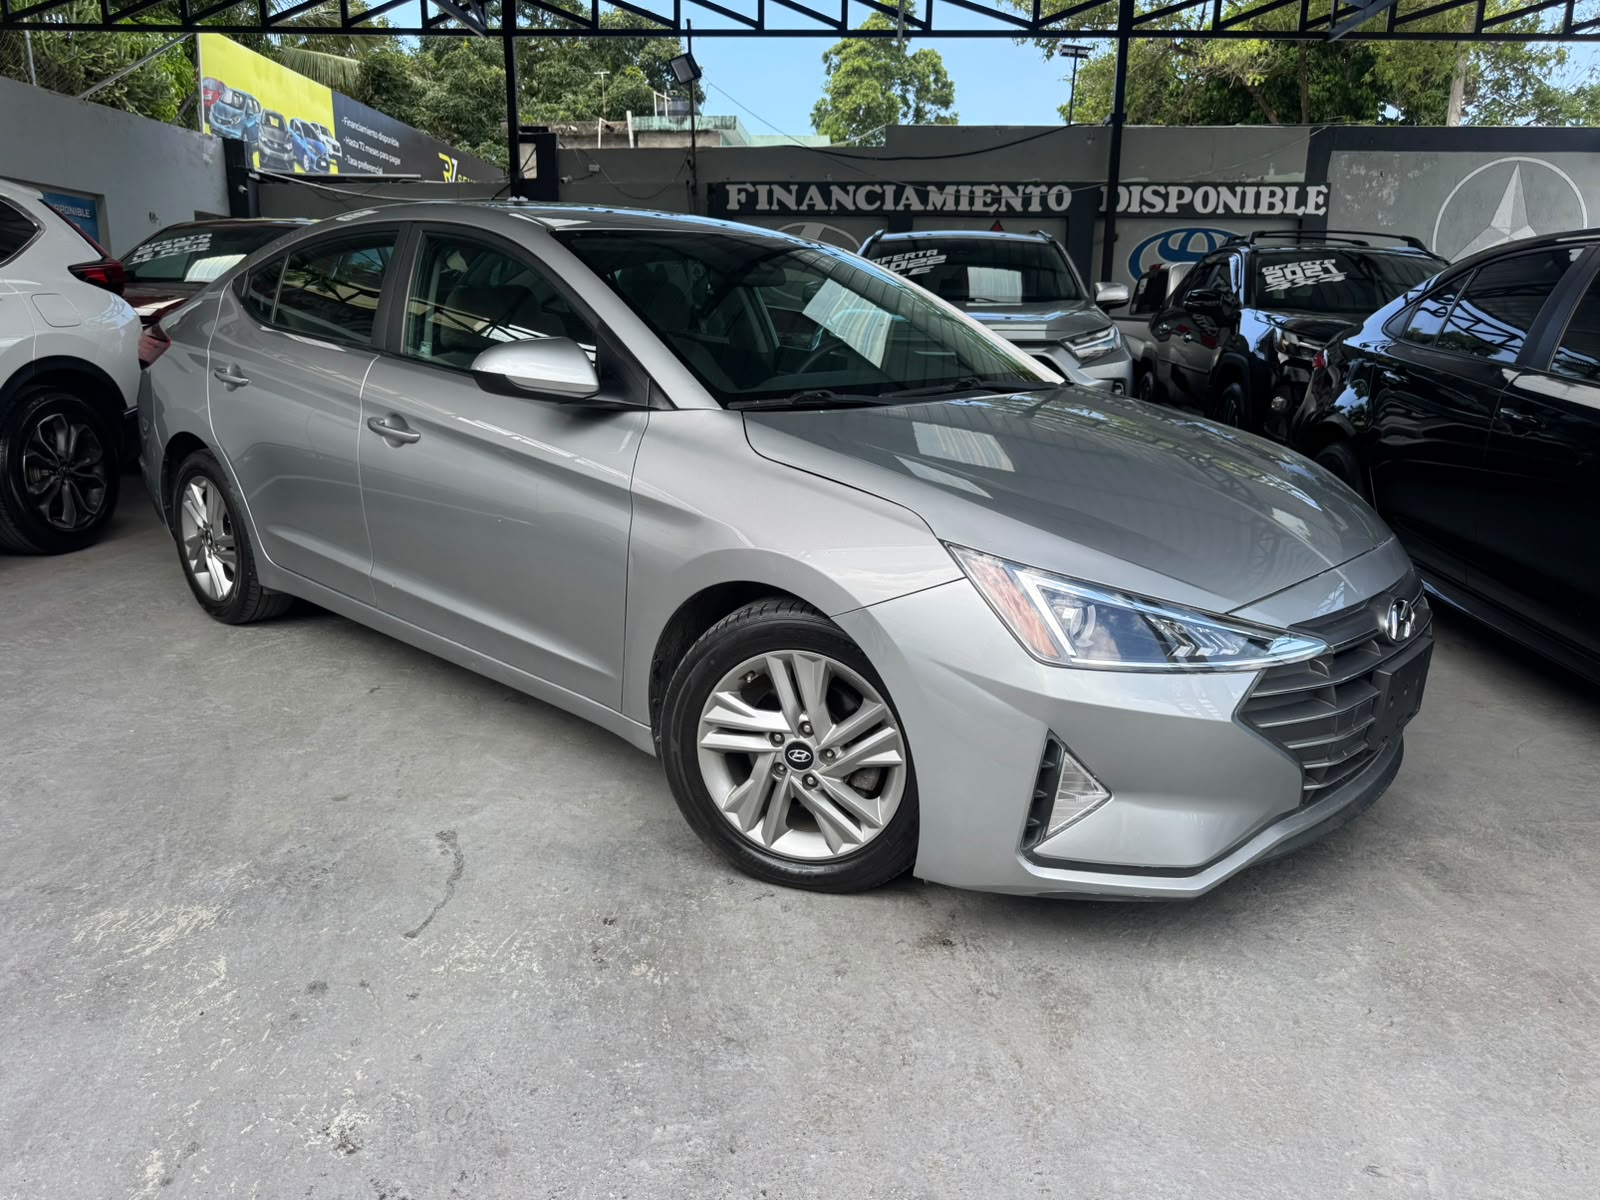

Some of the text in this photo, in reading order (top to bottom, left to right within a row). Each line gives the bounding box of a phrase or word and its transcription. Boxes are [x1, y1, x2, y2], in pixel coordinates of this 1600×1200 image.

[726, 184, 1329, 216] FINANCIAMIENTO DISPONIBLE
[1263, 263, 1341, 284] 2021
